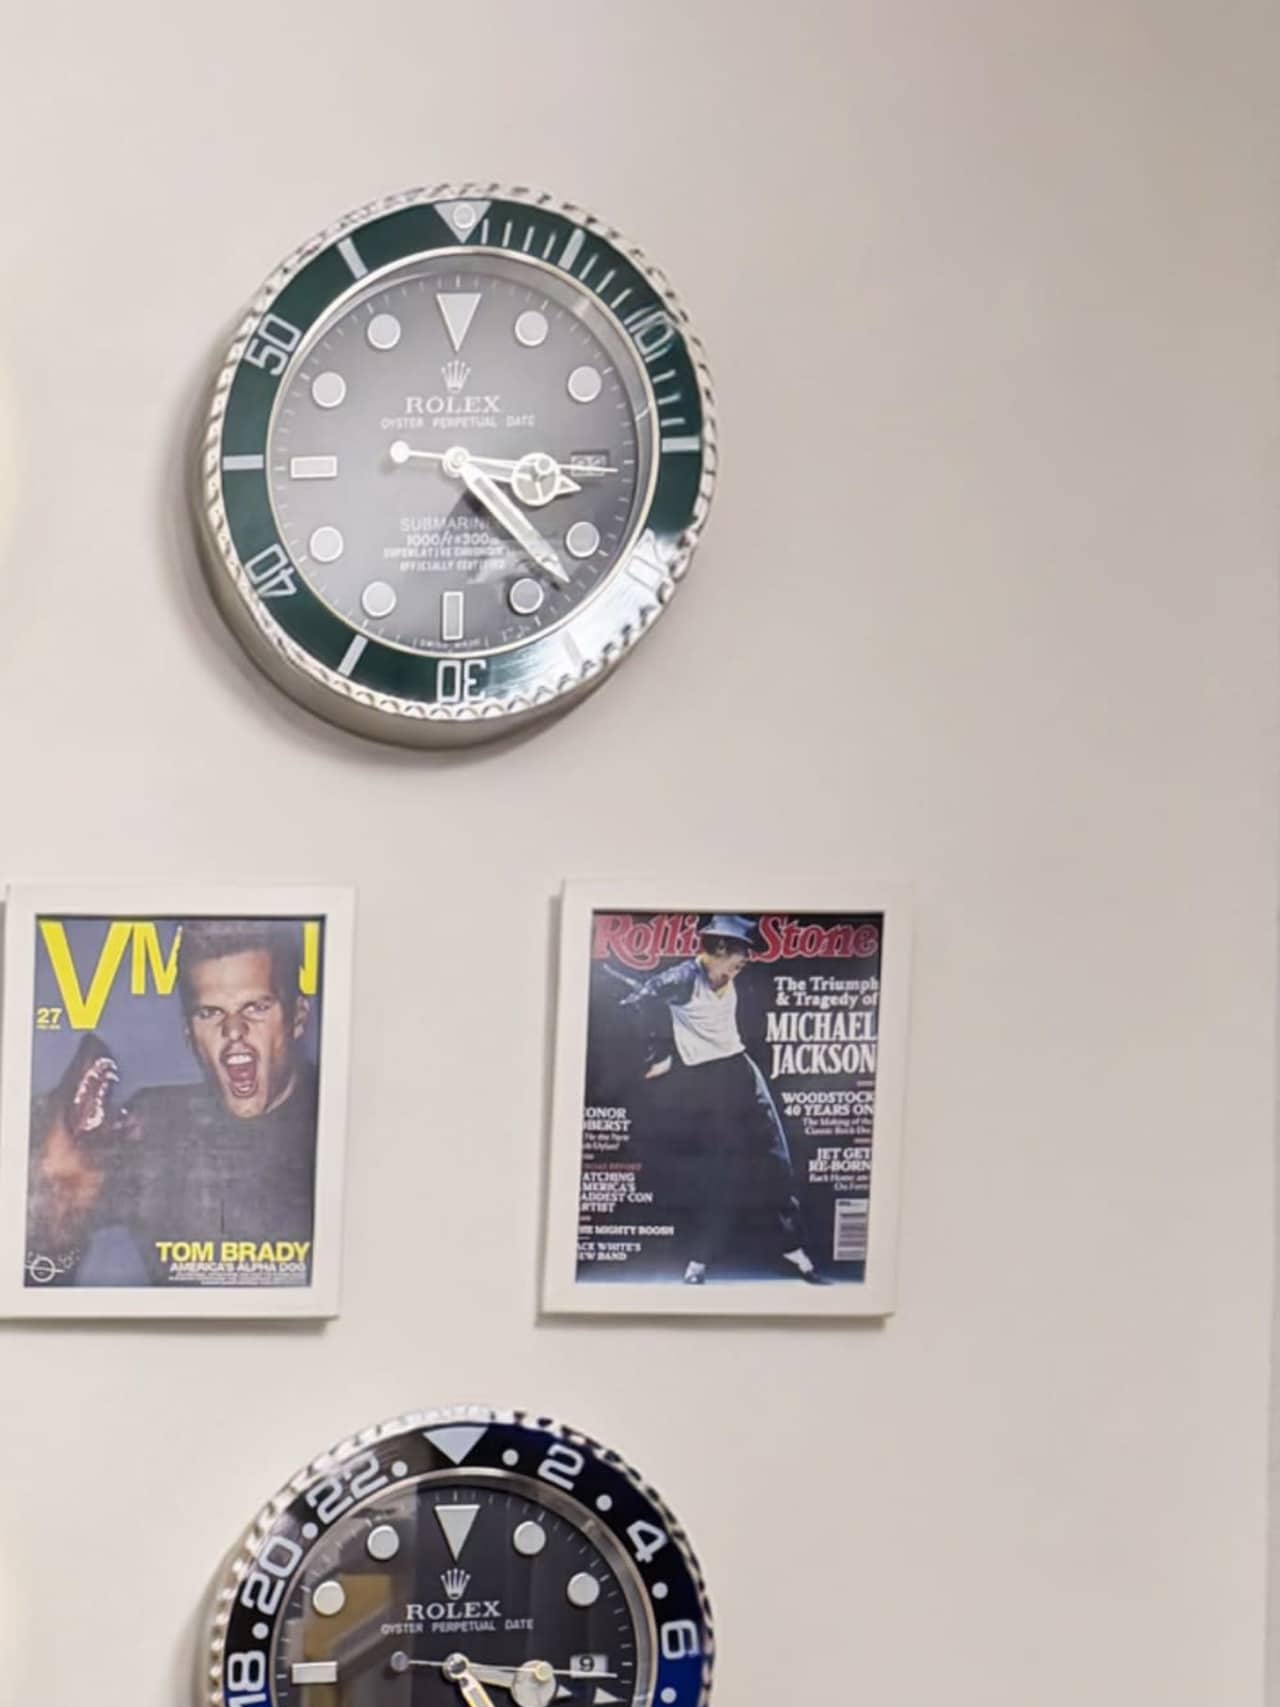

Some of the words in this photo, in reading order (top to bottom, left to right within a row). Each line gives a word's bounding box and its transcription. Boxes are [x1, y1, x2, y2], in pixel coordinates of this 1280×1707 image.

[245, 314, 301, 376] 50
[405, 396, 501, 414] ROLEX
[506, 415, 536, 427] DATE
[245, 544, 296, 596] 40
[593, 914, 702, 971] Rolli
[752, 915, 879, 963] Stone
[774, 977, 806, 991] The
[810, 977, 880, 995] Triumph
[794, 993, 858, 1009] Tragedy
[37, 1009, 62, 1024] 27
[766, 1012, 878, 1042] MICHAEL
[770, 1044, 875, 1079] JACKSON
[782, 1092, 873, 1104] WOODSTOCK
[805, 1105, 850, 1116] YEARS
[156, 1242, 214, 1262] TOM
[221, 1242, 311, 1262] BRADY
[306, 1451, 386, 1524] 22
[242, 1536, 301, 1615] 20
[407, 1602, 501, 1620] ROLEX
[432, 1621, 496, 1632] PERPETUAL
[505, 1619, 533, 1630] DATE
[580, 1656, 594, 1671] 9
